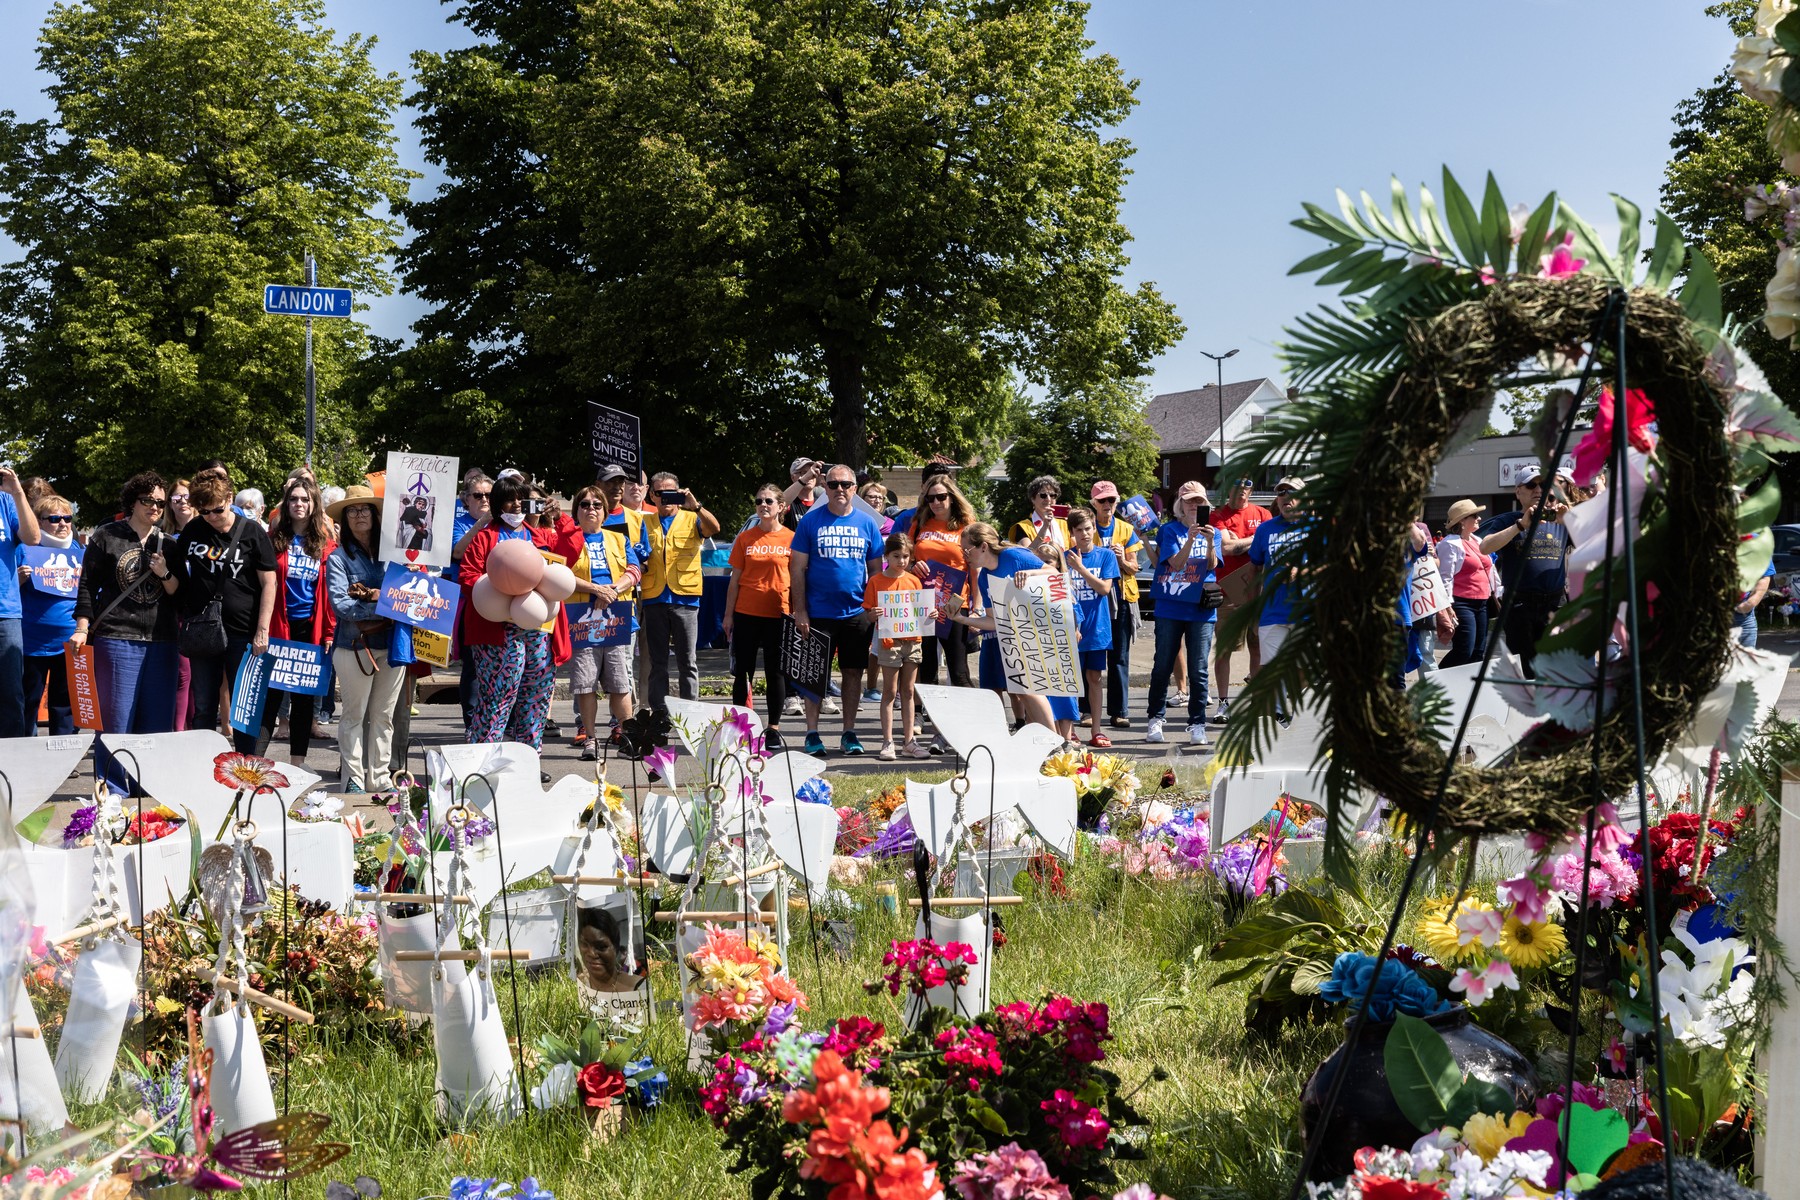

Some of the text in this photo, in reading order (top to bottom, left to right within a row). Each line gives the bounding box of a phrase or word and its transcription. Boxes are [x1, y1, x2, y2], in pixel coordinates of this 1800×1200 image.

[269, 290, 334, 312] LANDON
[594, 422, 633, 440] OUR FAMILY
[598, 415, 630, 431] OUR CITY
[592, 430, 636, 450] OUR FRIENDS
[592, 438, 637, 463] UNITED
[818, 526, 859, 536] MARCH
[818, 536, 865, 548] FOR OUR
[188, 541, 243, 563] EQUAL
[746, 545, 791, 556] ENOUGH
[818, 548, 850, 559] LIVES
[35, 567, 69, 577] PROTECT
[43, 578, 78, 589] NOT GUN
[387, 587, 427, 605] PROTECT
[884, 592, 920, 604] PROTECT
[392, 601, 412, 614] NOT
[884, 607, 928, 618] LIVES NOT
[568, 619, 603, 631] PROTECT
[894, 620, 918, 633] GUNS!
[413, 628, 440, 641] ayers
[574, 631, 589, 641] NOT
[991, 595, 1029, 689] ASSAULT
[1029, 586, 1064, 692] ARE WEAPONS
[1048, 574, 1078, 694] DESIGNED FOR WAR
[413, 638, 430, 649] tion
[1012, 604, 1048, 692] WEAPONS
[268, 644, 316, 662] MARCH
[426, 652, 444, 662] doing?
[791, 626, 802, 679] UNITED
[273, 659, 321, 676] OR OUR
[270, 670, 300, 686] IVES
[80, 654, 94, 719] WE CAN END
[244, 659, 264, 726] EVERYTOWN
[75, 673, 88, 724] VIOLENCE
